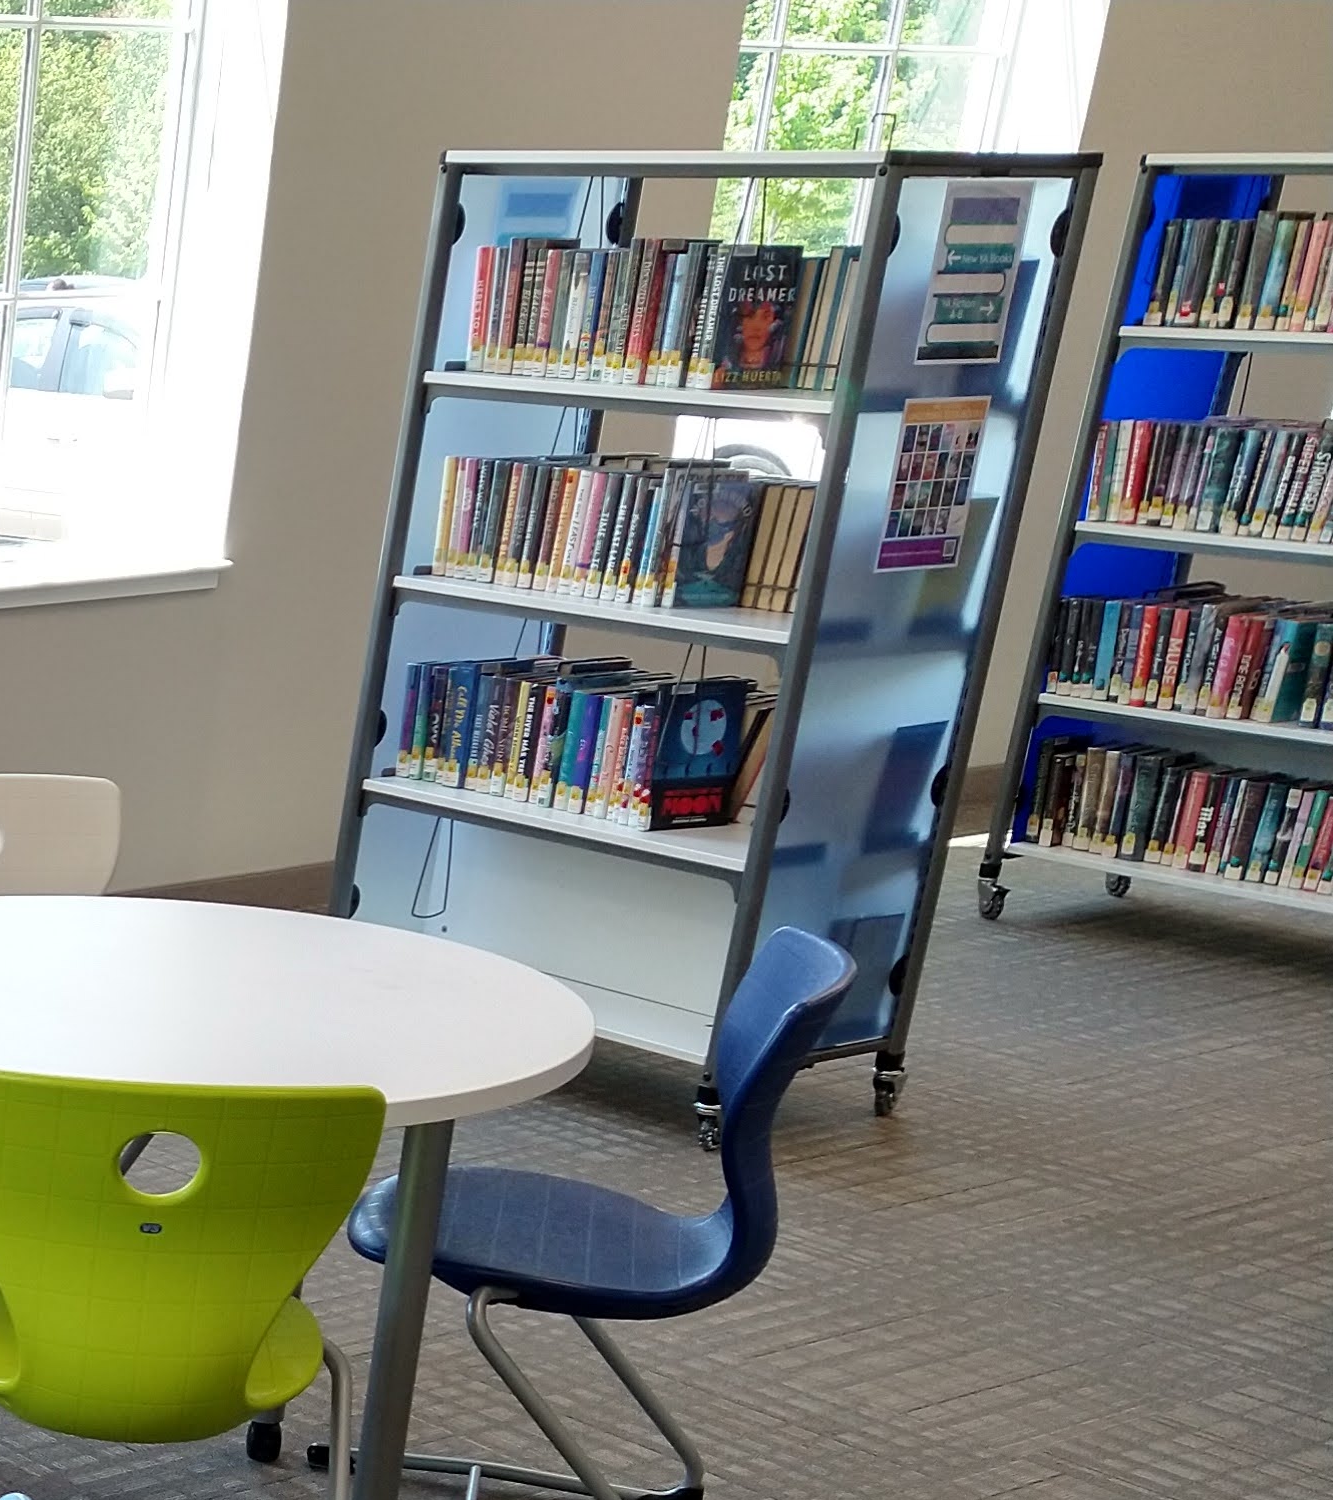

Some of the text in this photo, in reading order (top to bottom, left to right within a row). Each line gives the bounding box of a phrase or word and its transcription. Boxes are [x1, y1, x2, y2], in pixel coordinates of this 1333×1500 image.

[744, 264, 788, 282] LOST
[704, 255, 725, 341] THE LOST DREAMER
[728, 287, 797, 302] DREAMER
[1296, 435, 1317, 474] SUPER
[1301, 449, 1331, 513] STRONGER
[501, 475, 518, 542] DANGEROUS
[617, 504, 626, 521] THE
[568, 521, 579, 547] LEAST
[597, 511, 609, 536] TIME
[612, 524, 622, 546] LAST
[1162, 637, 1184, 685] MUSE
[527, 696, 535, 712] THE
[484, 704, 500, 735] Violet
[522, 714, 532, 737] RIVER
[1194, 804, 1213, 837] Max
